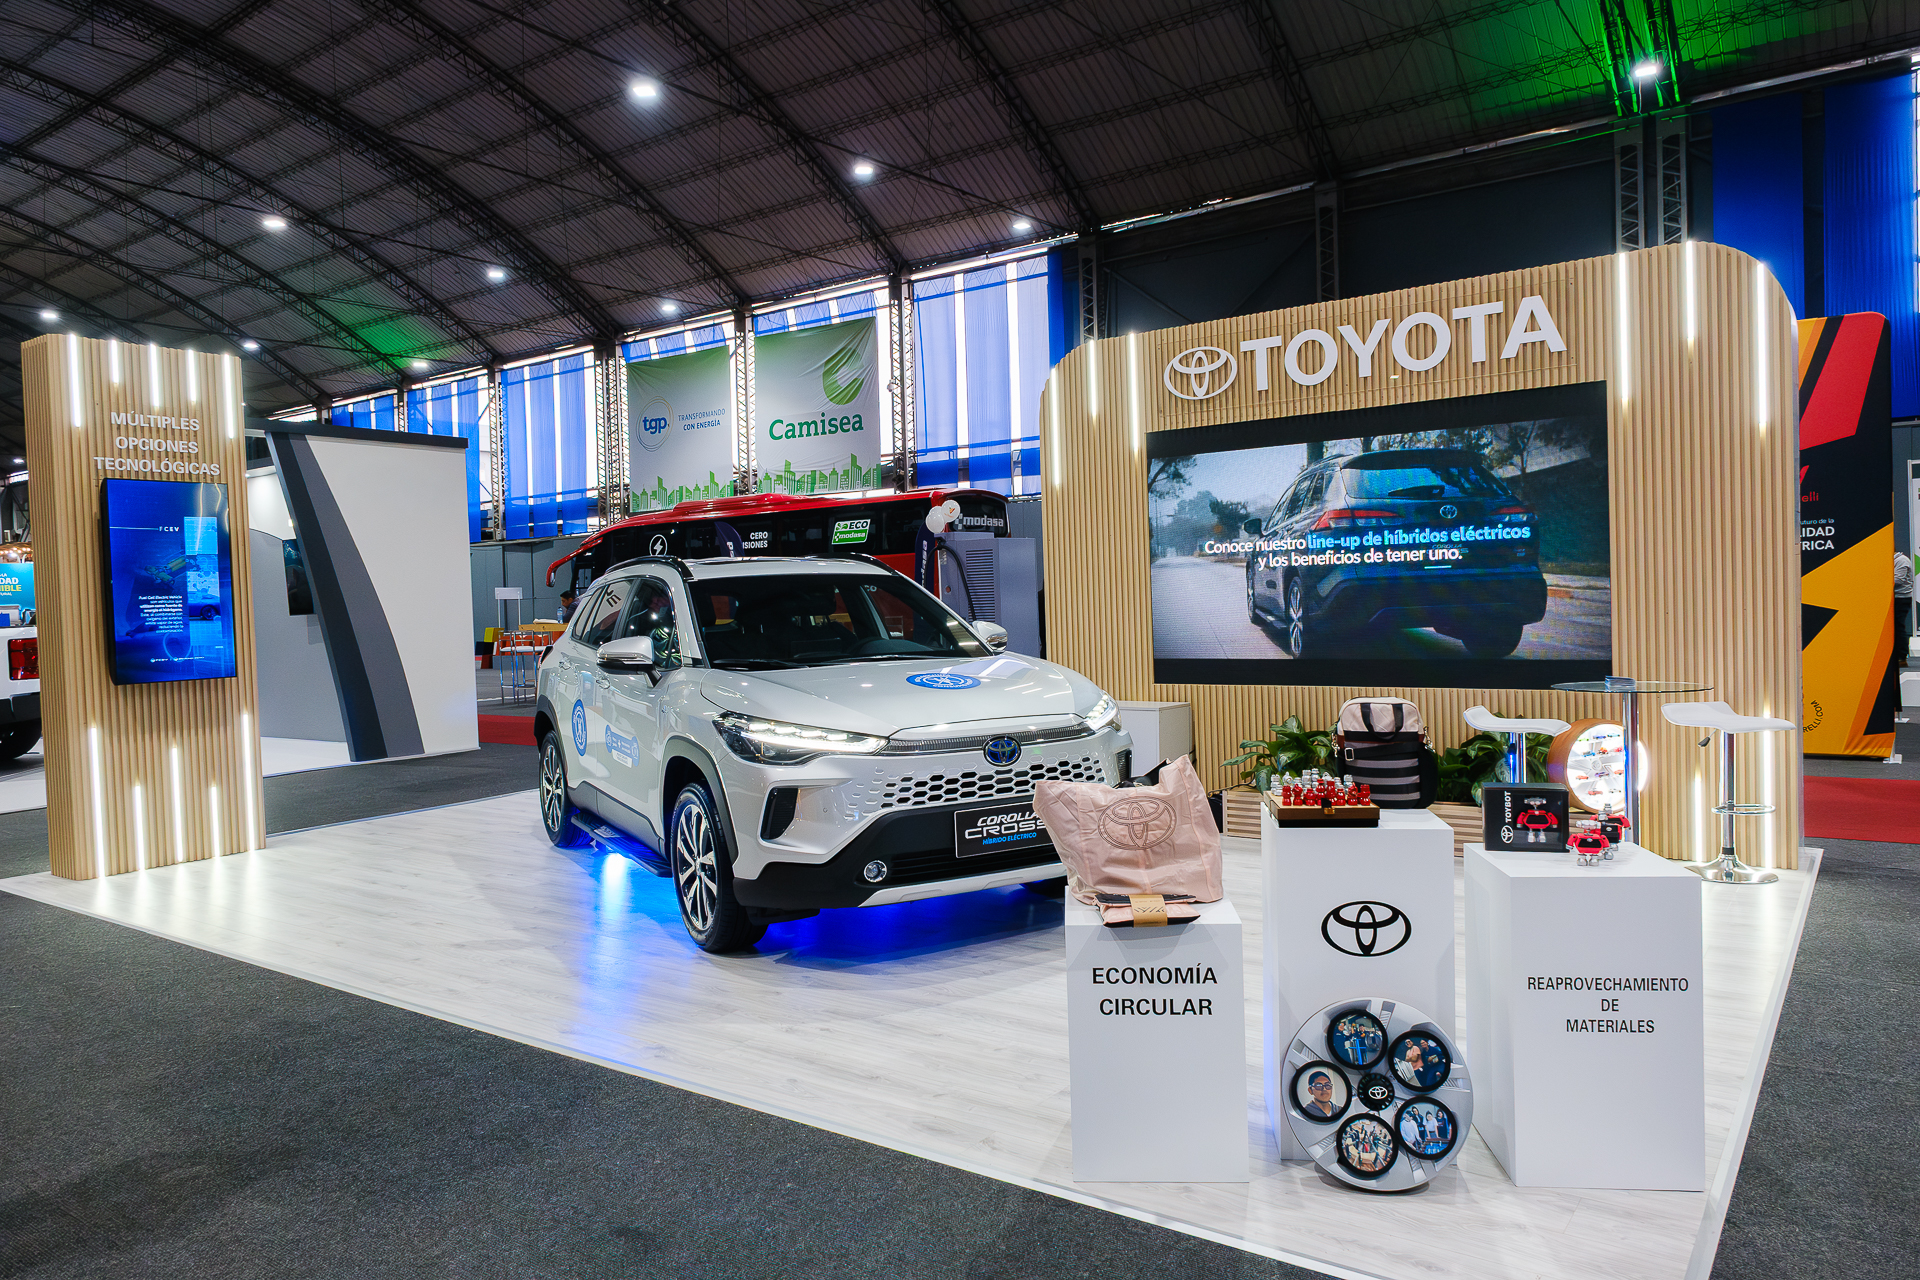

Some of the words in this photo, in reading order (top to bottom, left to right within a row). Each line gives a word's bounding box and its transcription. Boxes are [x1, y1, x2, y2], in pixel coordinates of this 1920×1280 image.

[1240, 295, 1567, 391] TOYOTA
[110, 410, 200, 431] MÚLTIPLES
[678, 408, 726, 421] TRANSFORMANDO
[642, 416, 668, 435] tgp
[683, 423, 695, 431] CON
[696, 418, 721, 430] ENERGÍA
[769, 412, 864, 441] Camisea
[115, 436, 199, 454] OPCIONES
[93, 457, 220, 476] TECNOLÓGICAS
[849, 521, 869, 530] ECO
[963, 515, 1004, 527] modasa
[750, 532, 768, 540] CERO
[1204, 540, 1254, 554] Conoce
[1255, 537, 1307, 552] nuestro
[1307, 532, 1362, 551] line-up
[1362, 531, 1383, 546] de
[1384, 528, 1449, 545] híbridos
[1450, 523, 1531, 542] eléctricos
[1800, 526, 1835, 537] IDAD
[1800, 540, 1835, 550] RICA
[1258, 555, 1267, 571] y
[1269, 553, 1288, 567] los
[1291, 549, 1361, 567] beneficios
[1363, 547, 1383, 563] de
[1386, 549, 1426, 563] tener
[1428, 548, 1463, 561] uno.
[977, 812, 1039, 827] COROLLA
[982, 836, 1007, 845] HÍBRIDO
[1007, 832, 1037, 842] ELÉCTRICO
[1092, 962, 1218, 985] ECONOMÍA
[1527, 976, 1689, 992] REAPROVECHAMIENTO
[1099, 998, 1213, 1016] CIRCULAR
[1601, 999, 1619, 1012] DE
[1566, 1019, 1655, 1034] MATERIALES
